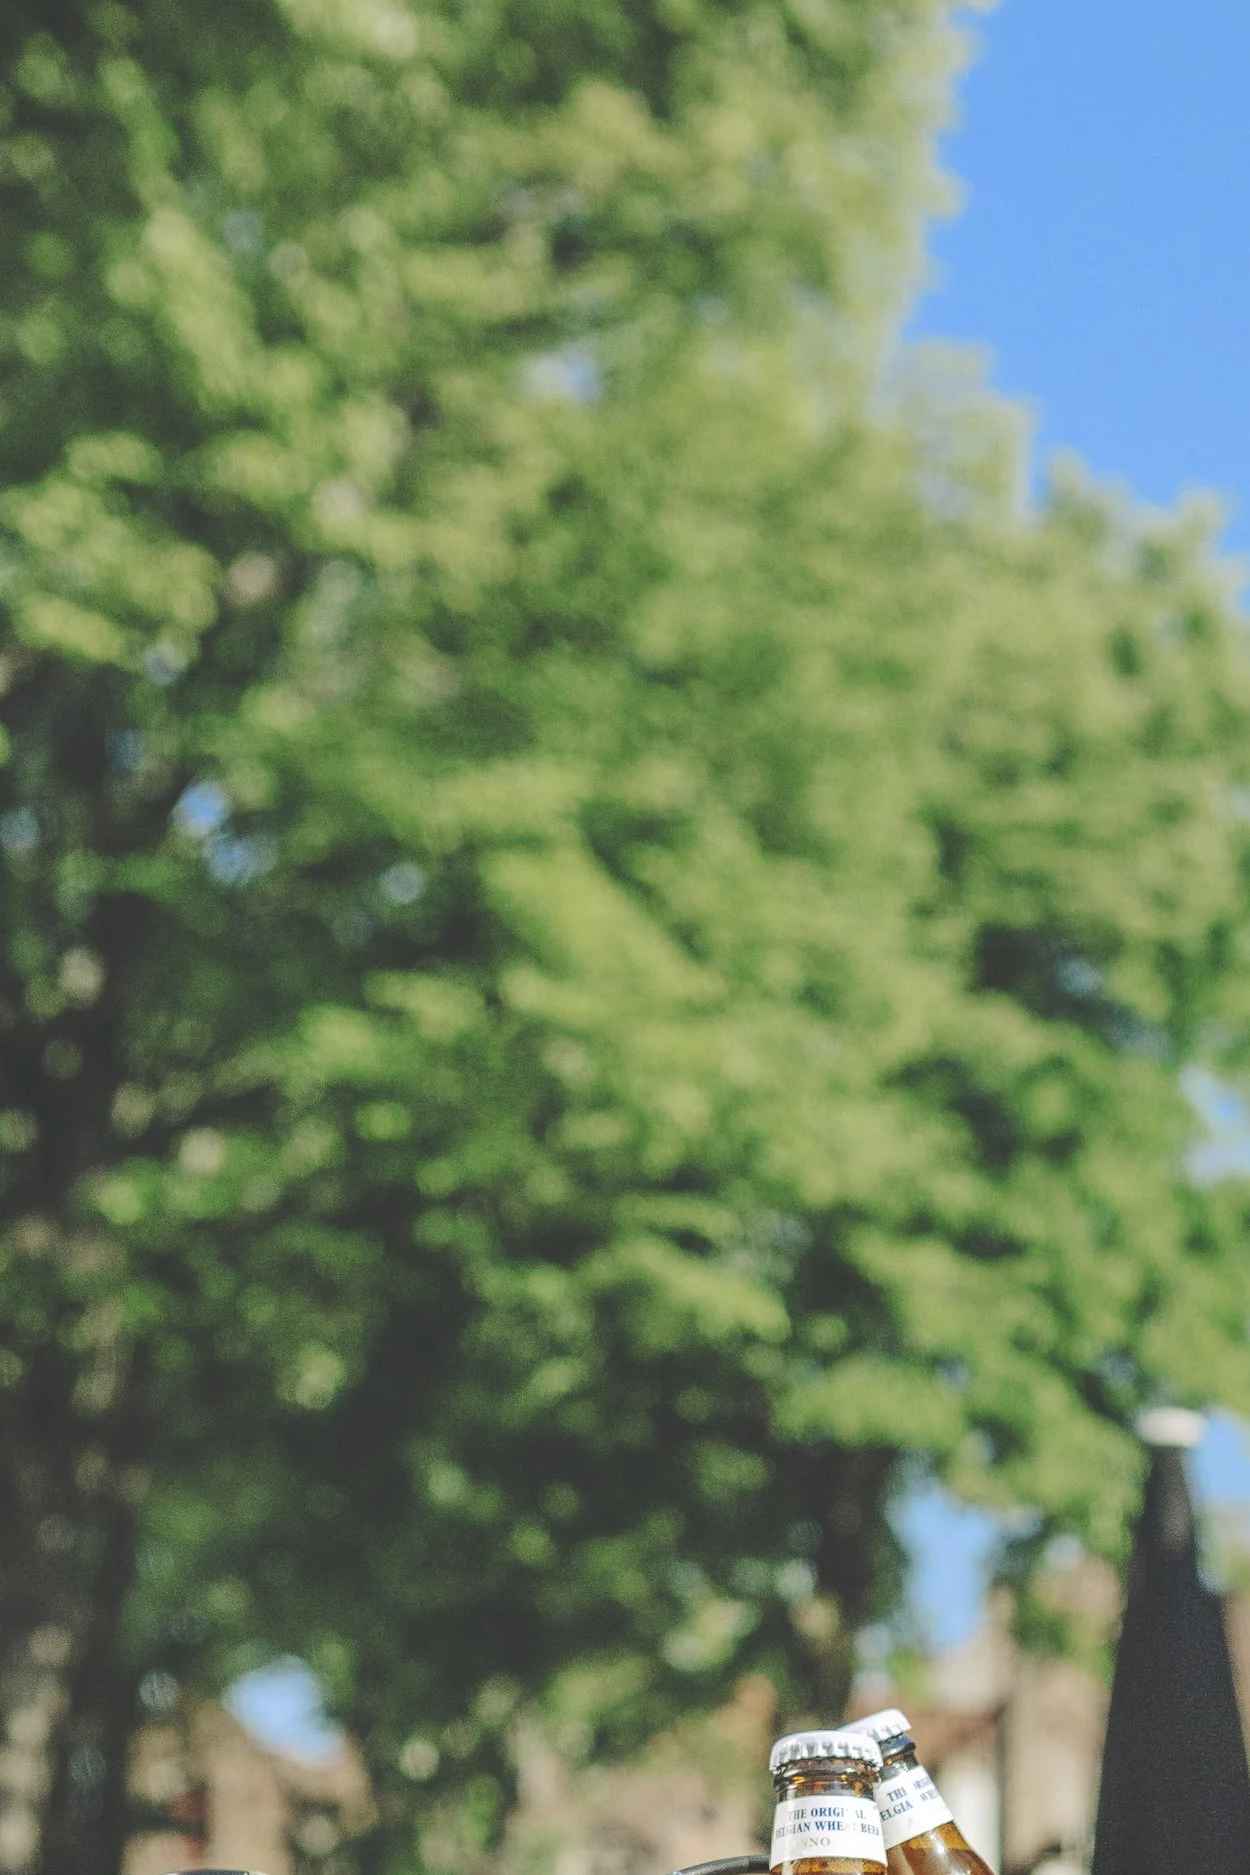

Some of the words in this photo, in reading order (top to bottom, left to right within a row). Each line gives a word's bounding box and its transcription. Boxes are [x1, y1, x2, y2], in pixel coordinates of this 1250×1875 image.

[788, 1808, 808, 1821] THE
[810, 1806, 867, 1820] ORIGIL
[880, 1799, 914, 1821] ELGIA
[795, 1836, 832, 1848] NNO
